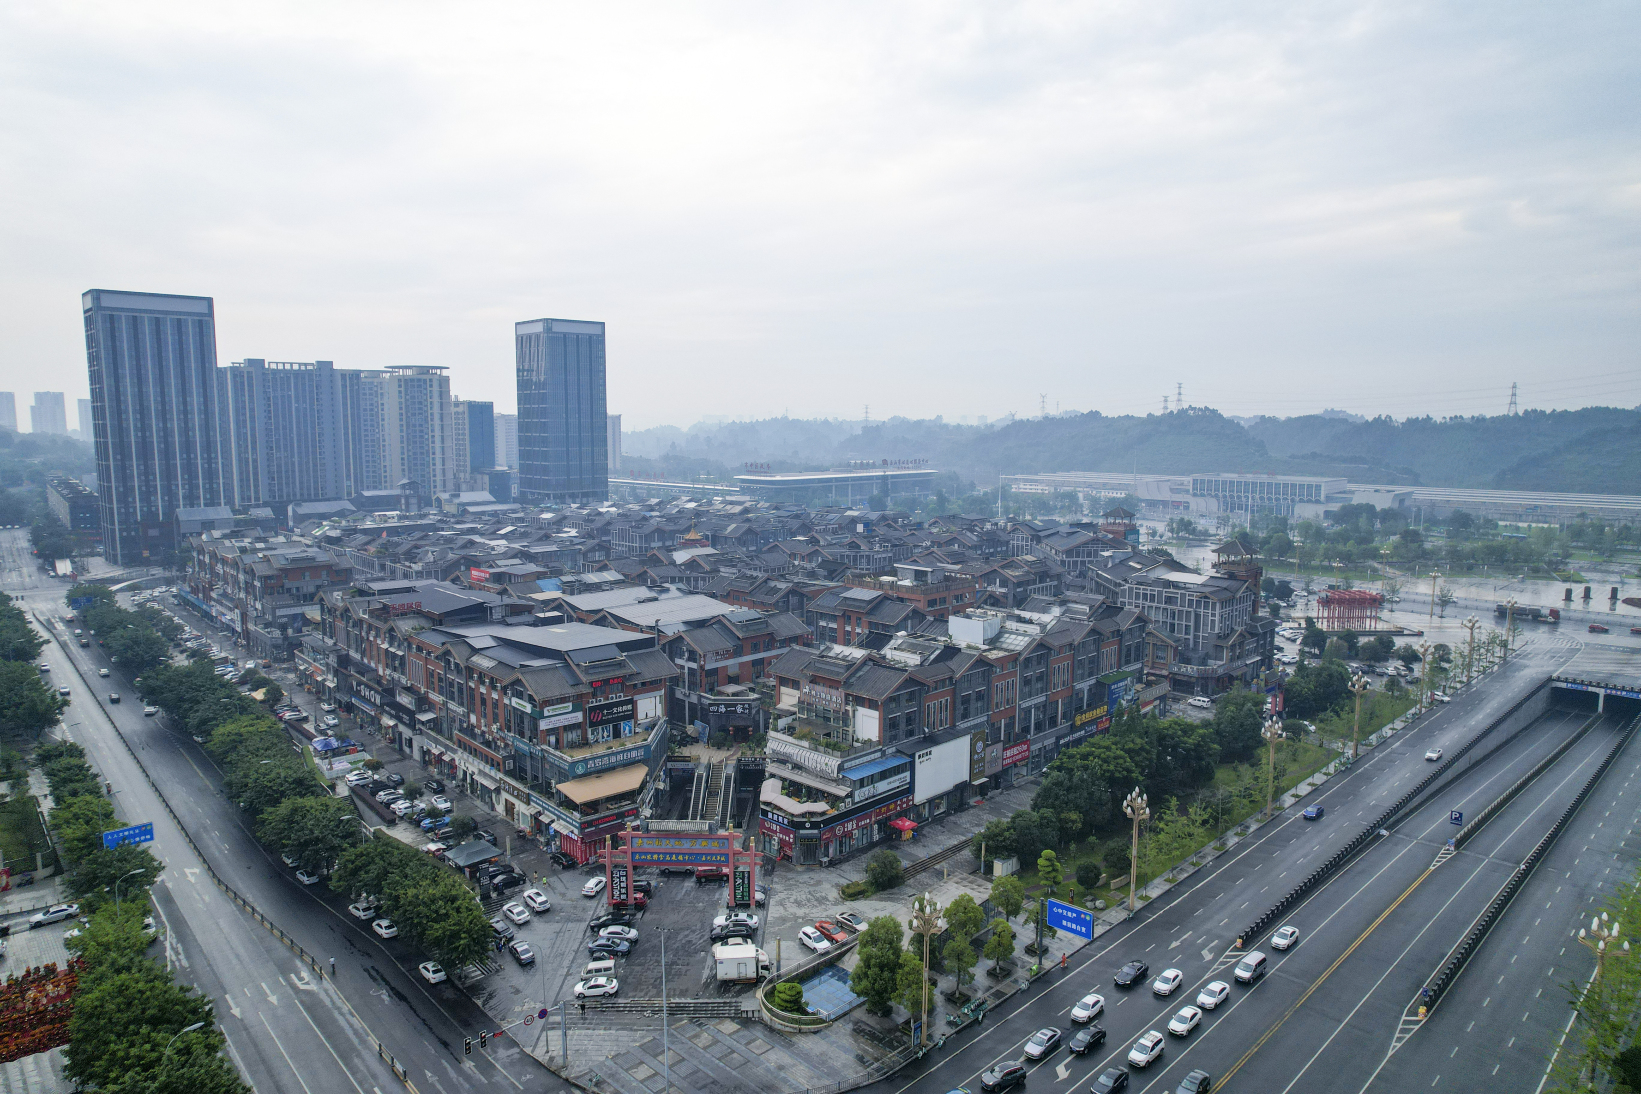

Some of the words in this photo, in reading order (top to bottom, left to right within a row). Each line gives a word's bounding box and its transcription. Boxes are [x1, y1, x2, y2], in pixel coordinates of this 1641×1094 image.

[352, 680, 381, 706] Y-SHOW
[709, 704, 744, 714] 四海一家
[1452, 811, 1460, 819] P
